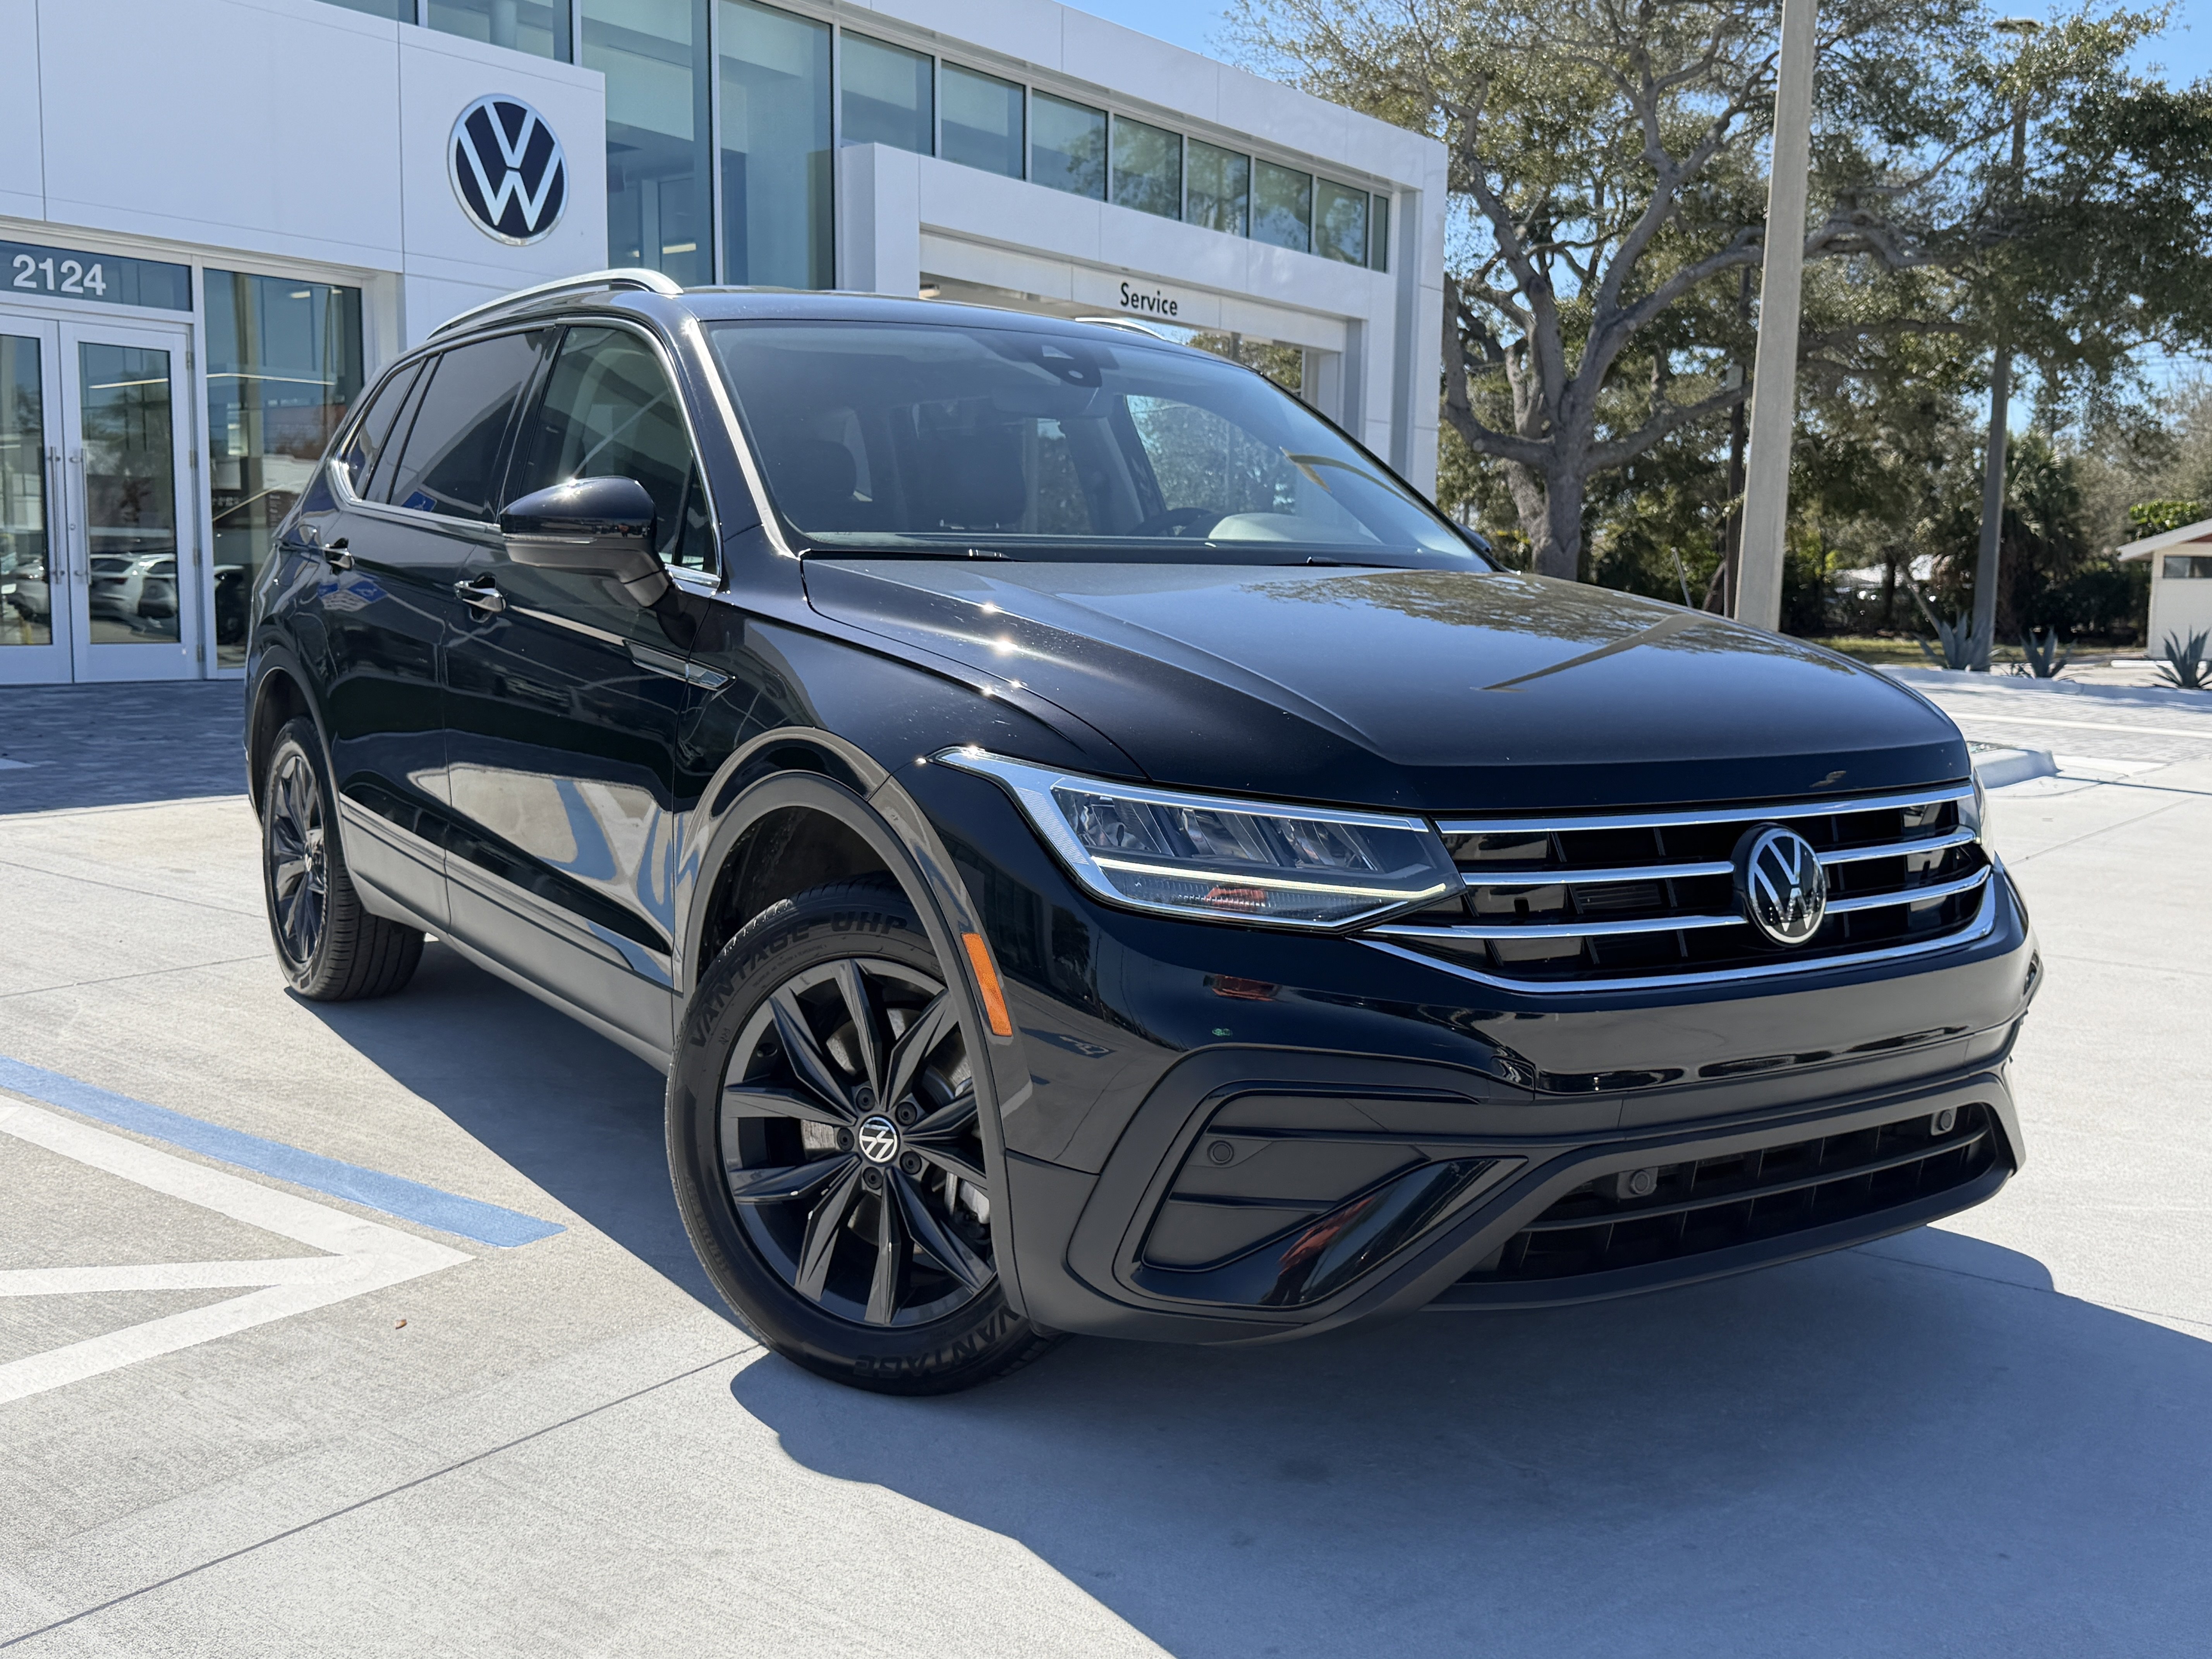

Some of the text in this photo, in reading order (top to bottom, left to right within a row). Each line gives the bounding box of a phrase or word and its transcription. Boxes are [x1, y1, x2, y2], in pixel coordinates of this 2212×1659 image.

[452, 96, 565, 239] VW
[13, 254, 106, 296] 2124
[1120, 282, 1177, 316] Service
[1750, 831, 1822, 938] VW
[689, 919, 810, 1048] VANTAGE
[831, 910, 908, 934] UHP
[859, 1118, 897, 1162] VW
[853, 1305, 1020, 1379] VANTAGE
